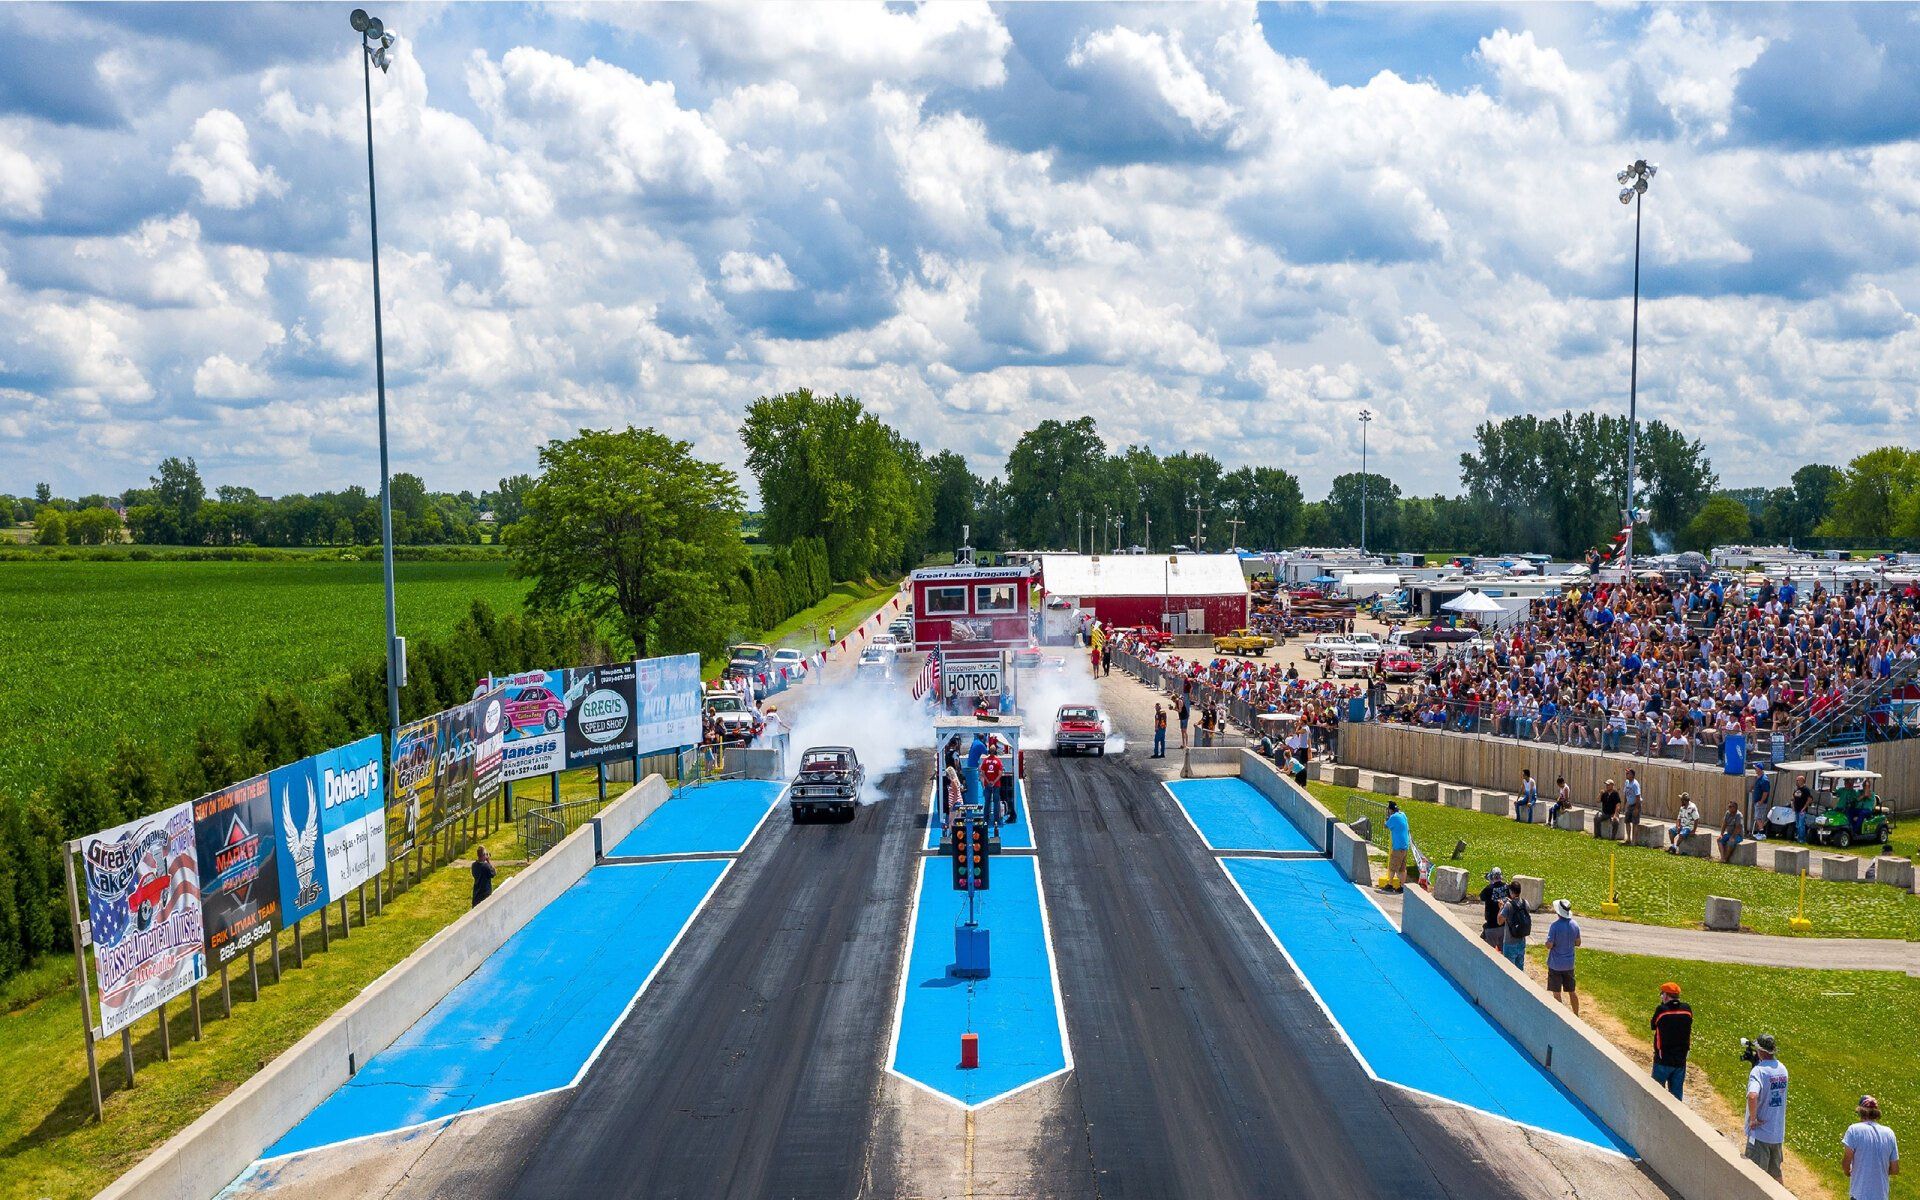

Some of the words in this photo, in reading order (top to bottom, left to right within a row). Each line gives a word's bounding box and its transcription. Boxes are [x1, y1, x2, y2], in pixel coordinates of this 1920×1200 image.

[974, 570, 1022, 578] Dragaway
[948, 673, 997, 691] HOTROD
[583, 698, 622, 718] GREG'S
[585, 720, 606, 734] SPEED
[606, 718, 624, 730] SHOP
[502, 740, 557, 761] anesis
[503, 755, 552, 769] RANSPORTATION
[324, 759, 378, 809] Doheny's
[195, 802, 209, 821] STAY
[209, 799, 216, 815] ON
[217, 793, 234, 812] TRACK
[234, 787, 246, 805] WITH
[247, 784, 256, 800] THE
[256, 779, 268, 797] BEST
[87, 861, 134, 894] Lakes
[132, 829, 169, 868] Dragaway
[88, 838, 130, 871] Great
[216, 839, 259, 873] MARKET
[211, 928, 228, 948] ERIK
[230, 912, 256, 937] LITWAK
[258, 900, 276, 921] TEAM
[100, 936, 133, 992] Classic
[133, 921, 171, 967] American
[171, 903, 204, 946] Muscle
[106, 1016, 115, 1030] For
[116, 1008, 128, 1023] more
